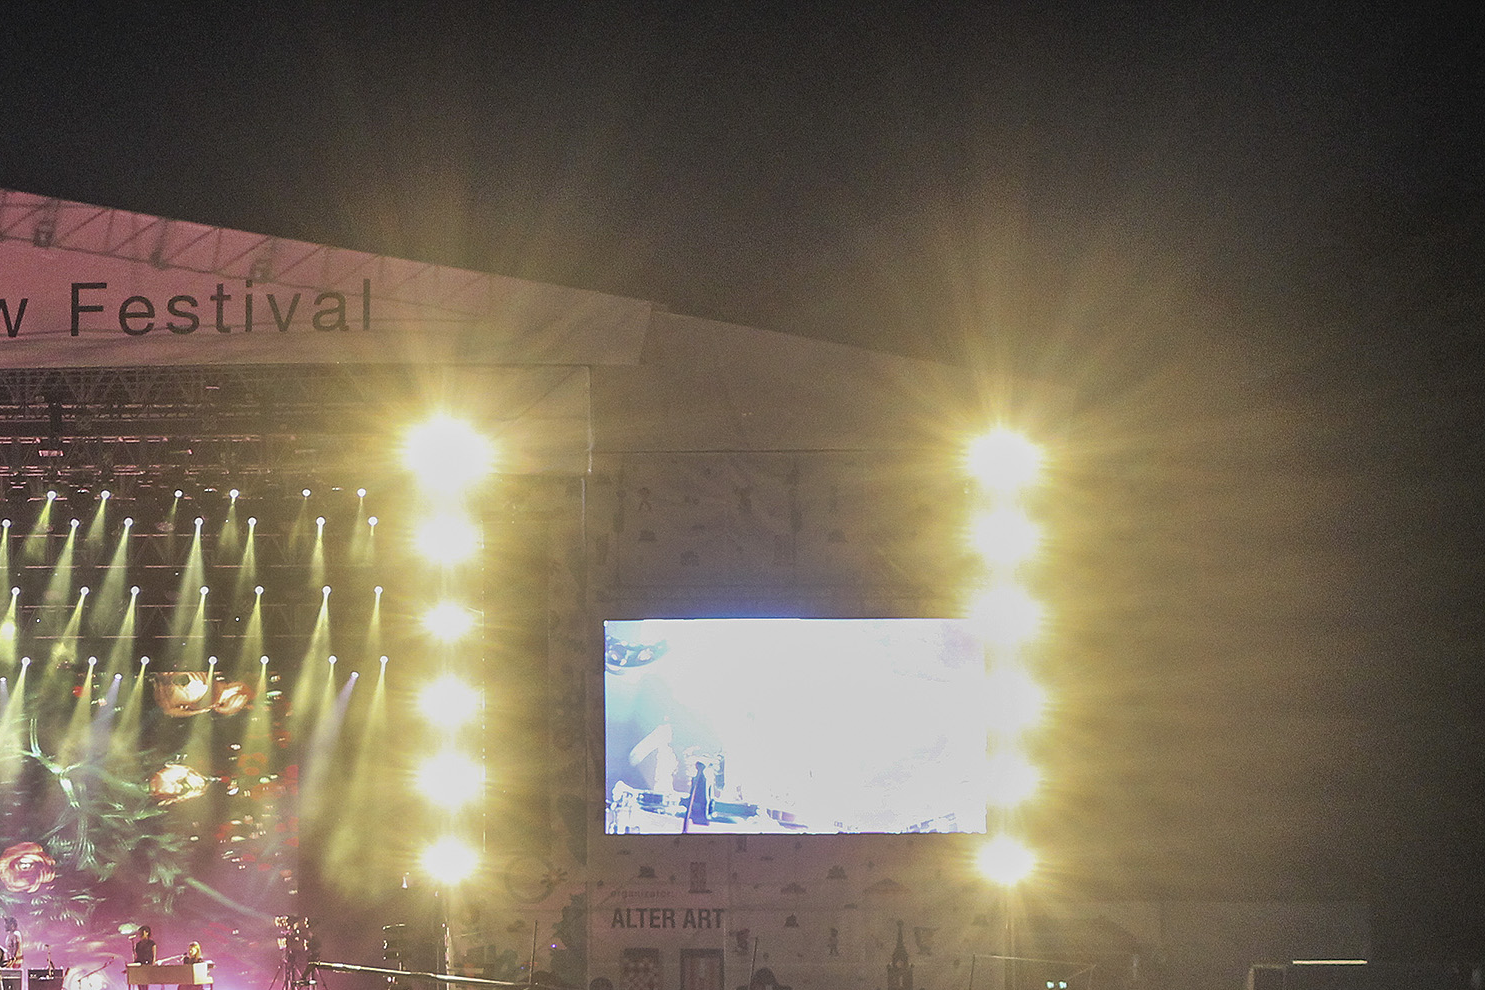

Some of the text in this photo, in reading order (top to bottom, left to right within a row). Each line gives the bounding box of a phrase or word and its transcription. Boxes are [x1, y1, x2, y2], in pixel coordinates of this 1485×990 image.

[69, 278, 372, 337] Festival
[611, 906, 725, 929] ALTER ART
